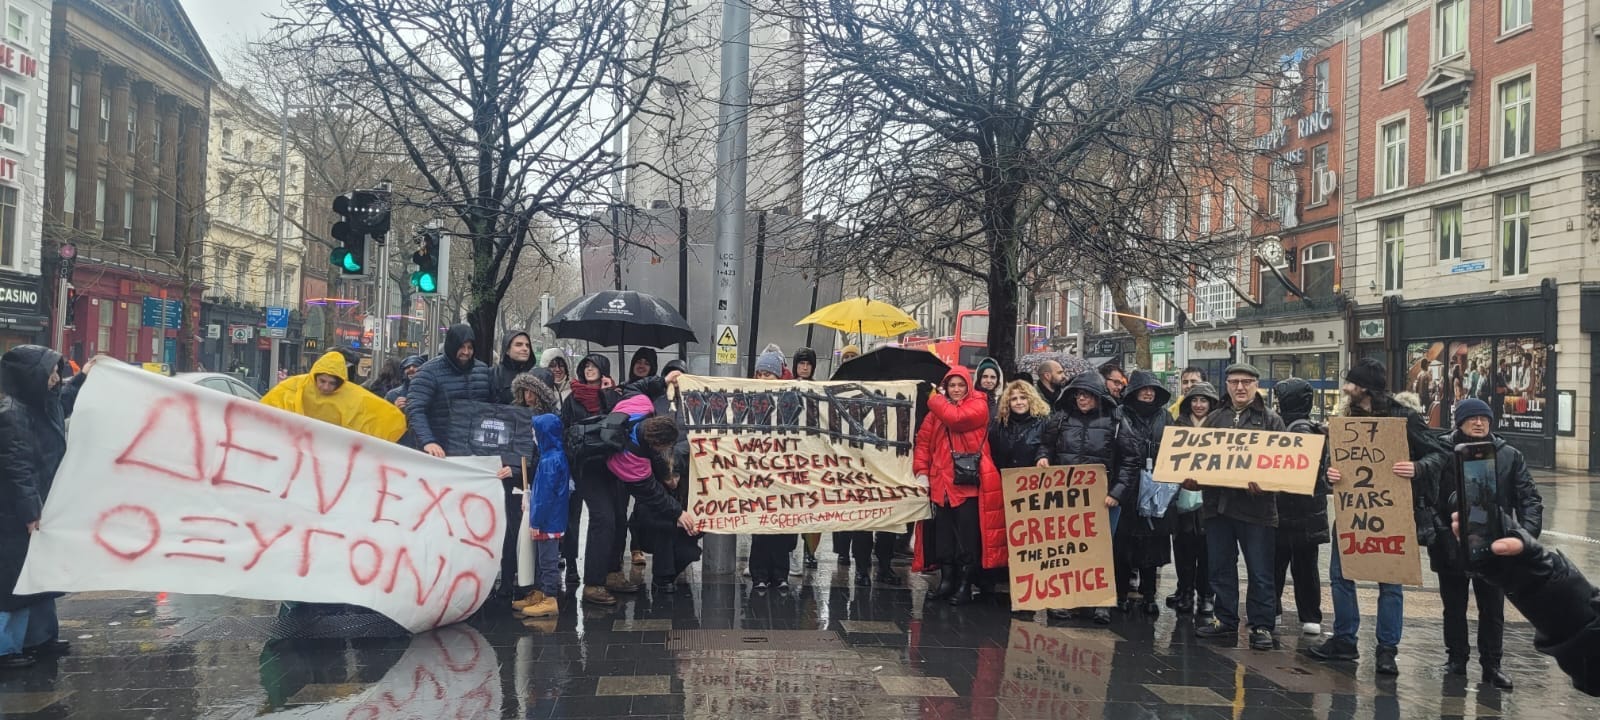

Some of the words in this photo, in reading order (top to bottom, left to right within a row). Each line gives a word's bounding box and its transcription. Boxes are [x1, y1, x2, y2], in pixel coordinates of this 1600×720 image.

[20, 54, 36, 78] IN
[0, 287, 38, 304] CASINO
[1527, 400, 1543, 412] JLL
[1172, 430, 1260, 448] JUSTICE
[1266, 434, 1304, 448] FOR
[1342, 421, 1379, 443] 57
[115, 393, 362, 514] ΔΕΝ
[691, 437, 721, 457] IT
[1334, 446, 1386, 464] DEAD
[711, 454, 738, 470] AN
[1170, 452, 1253, 472] TRAIN
[1256, 454, 1310, 470] DEAD
[697, 474, 725, 496] IT
[732, 473, 775, 489] WAS
[777, 471, 811, 485] THE
[820, 471, 880, 486] GREEK
[1015, 467, 1097, 493] 28/02/23
[1353, 465, 1375, 488] 2
[1011, 488, 1091, 513] TEMPI
[1338, 490, 1394, 511] YEARS
[695, 515, 749, 531] #TEMPI
[1009, 512, 1098, 547] GREECE
[1351, 512, 1385, 533] NO
[1017, 548, 1042, 562] THE
[1047, 541, 1089, 558] DEAD
[1340, 533, 1406, 555] JUSTICE
[1040, 557, 1070, 571] NEED
[1015, 567, 1109, 603] JUSTICE
